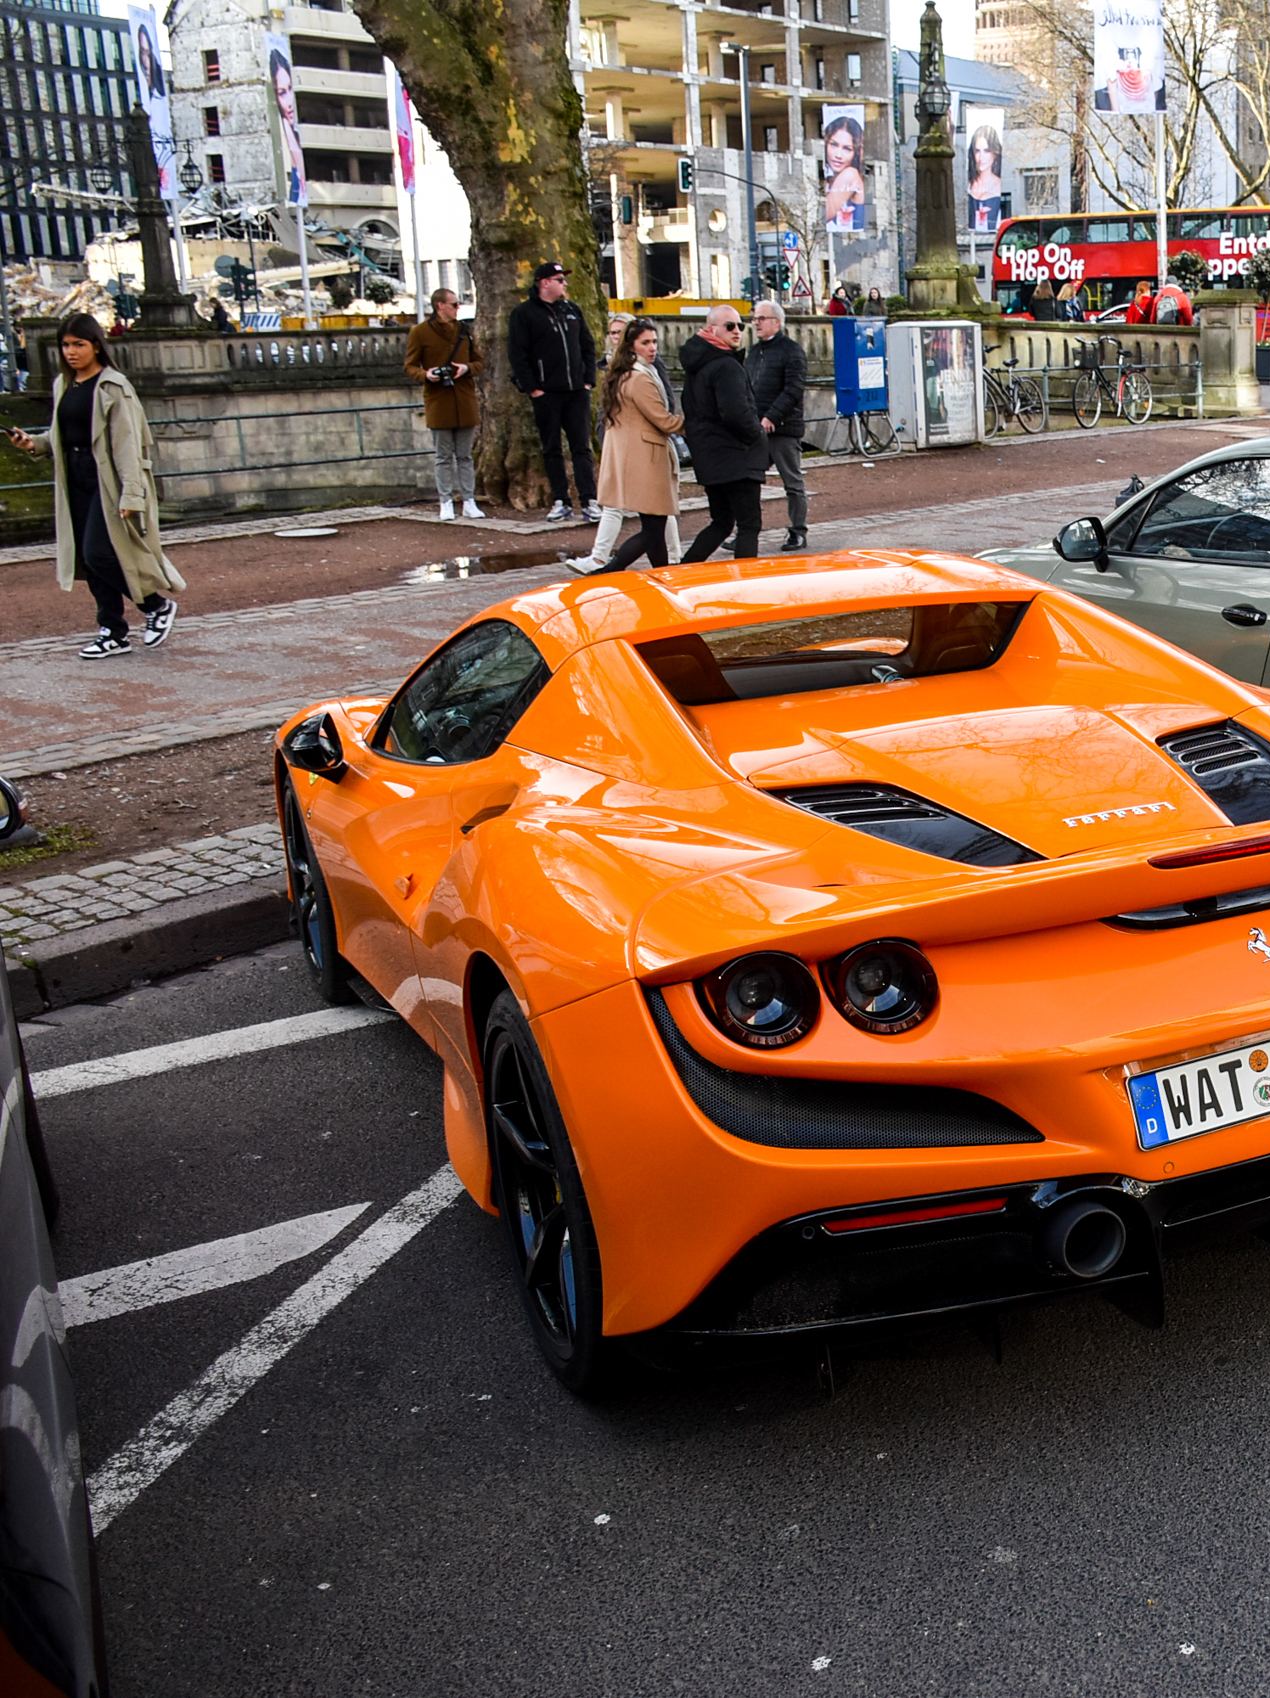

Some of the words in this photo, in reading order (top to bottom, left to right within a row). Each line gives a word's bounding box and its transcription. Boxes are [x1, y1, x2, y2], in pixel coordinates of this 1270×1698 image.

[1002, 244, 1039, 266] Hop
[1044, 243, 1072, 264] On
[1012, 261, 1049, 284] Hop
[1054, 259, 1085, 280] Off
[937, 369, 971, 383] JENNY
[936, 381, 974, 396] HOLZER
[1146, 1118, 1158, 1134] D
[1162, 1058, 1243, 1130] WAT
